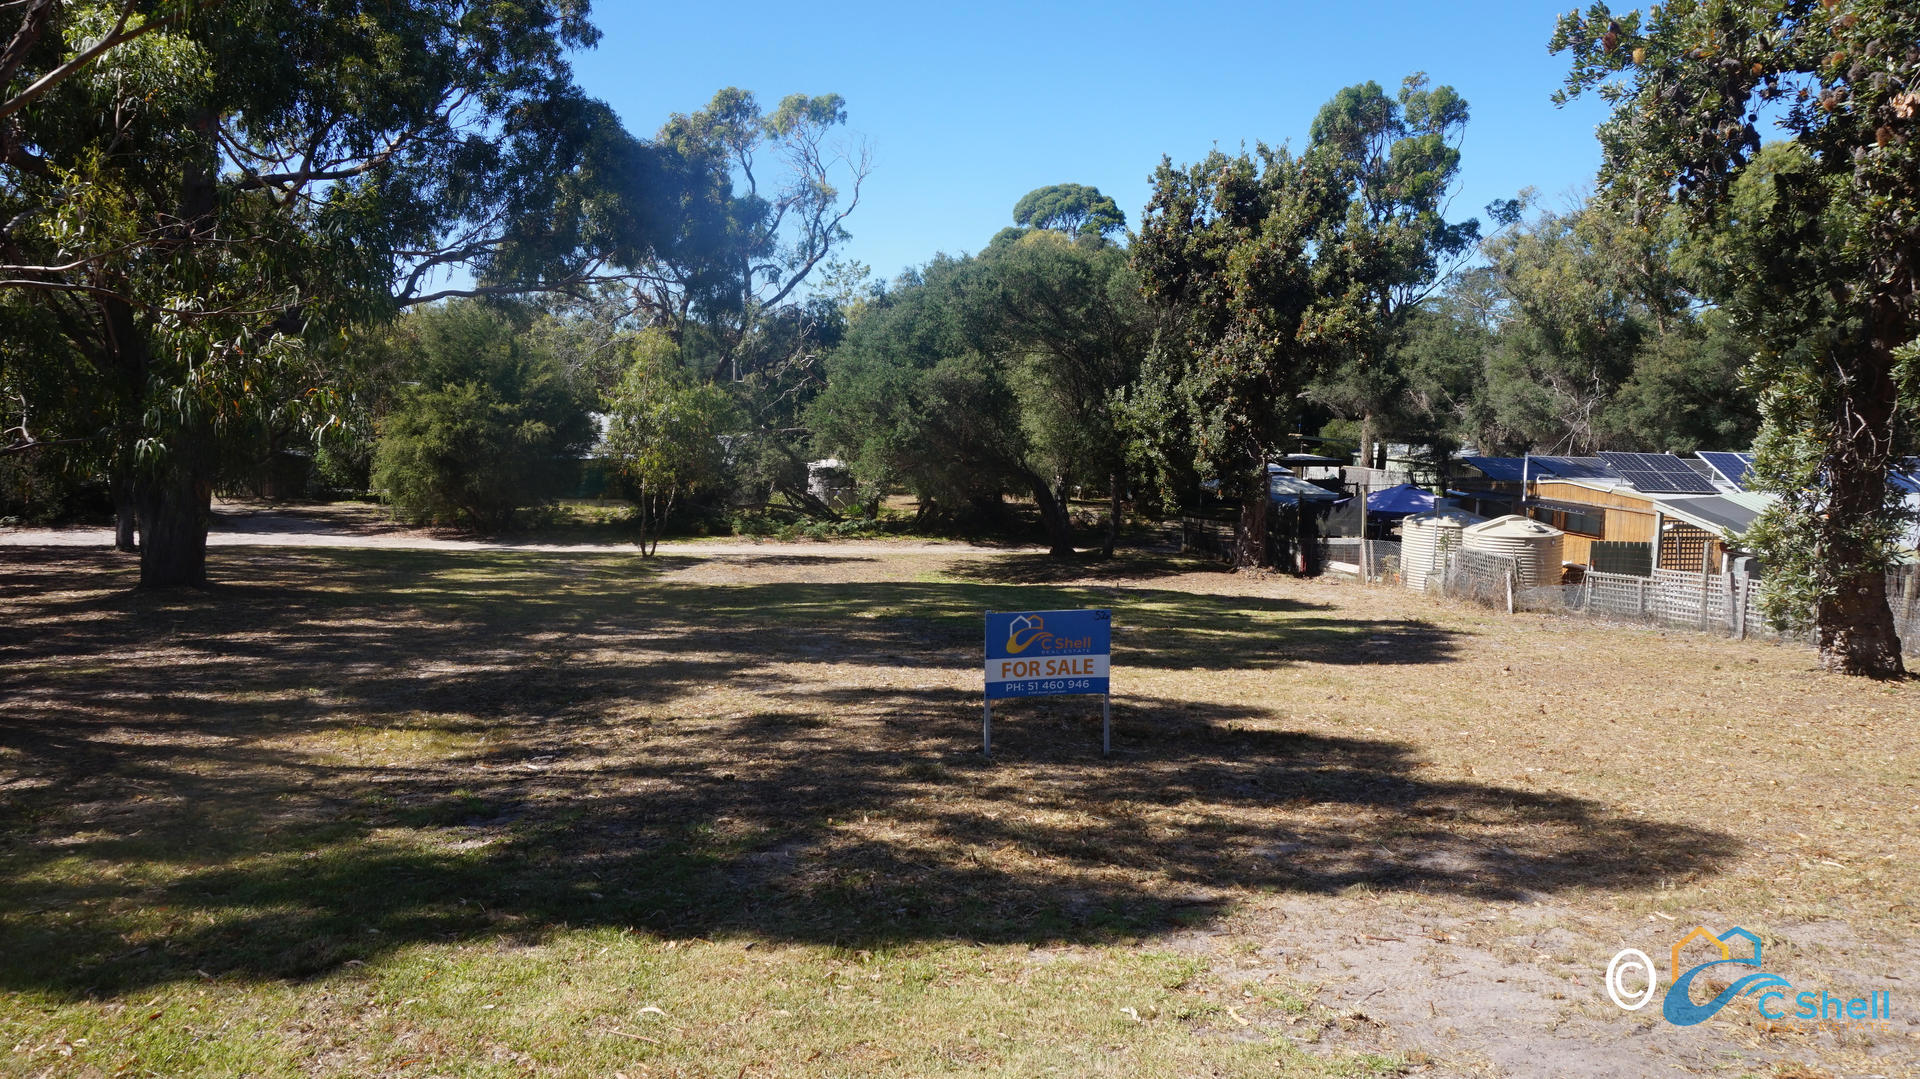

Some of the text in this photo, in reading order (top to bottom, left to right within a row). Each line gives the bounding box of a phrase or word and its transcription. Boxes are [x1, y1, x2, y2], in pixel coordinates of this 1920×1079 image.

[1041, 637, 1092, 650] C Shell
[1001, 658, 1094, 678] FOR SALE
[1005, 679, 1090, 692] PH: 51 460 946
